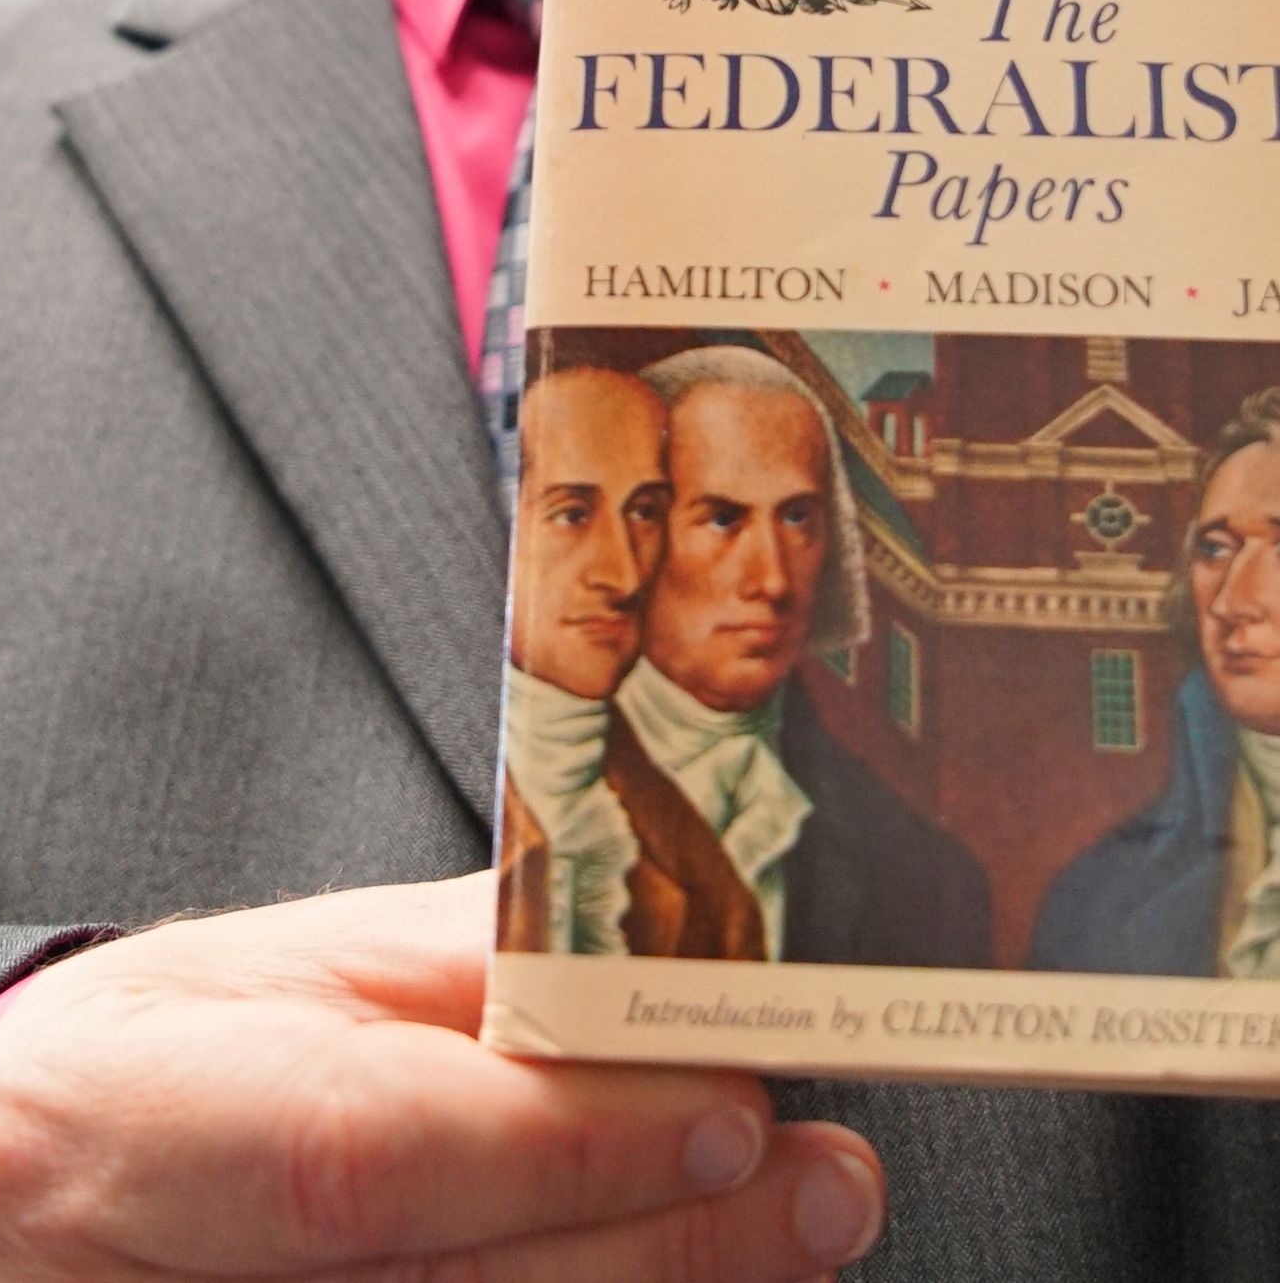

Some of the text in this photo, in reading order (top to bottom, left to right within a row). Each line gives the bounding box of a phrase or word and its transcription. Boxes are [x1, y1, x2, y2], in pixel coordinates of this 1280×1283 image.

[872, 150, 1129, 247] Papers
[584, 265, 845, 302] HAMILTON
[925, 270, 1153, 308] MADISON
[623, 989, 815, 1031] Introduction
[829, 996, 867, 1039] by
[881, 1000, 1075, 1041] CLINTON
